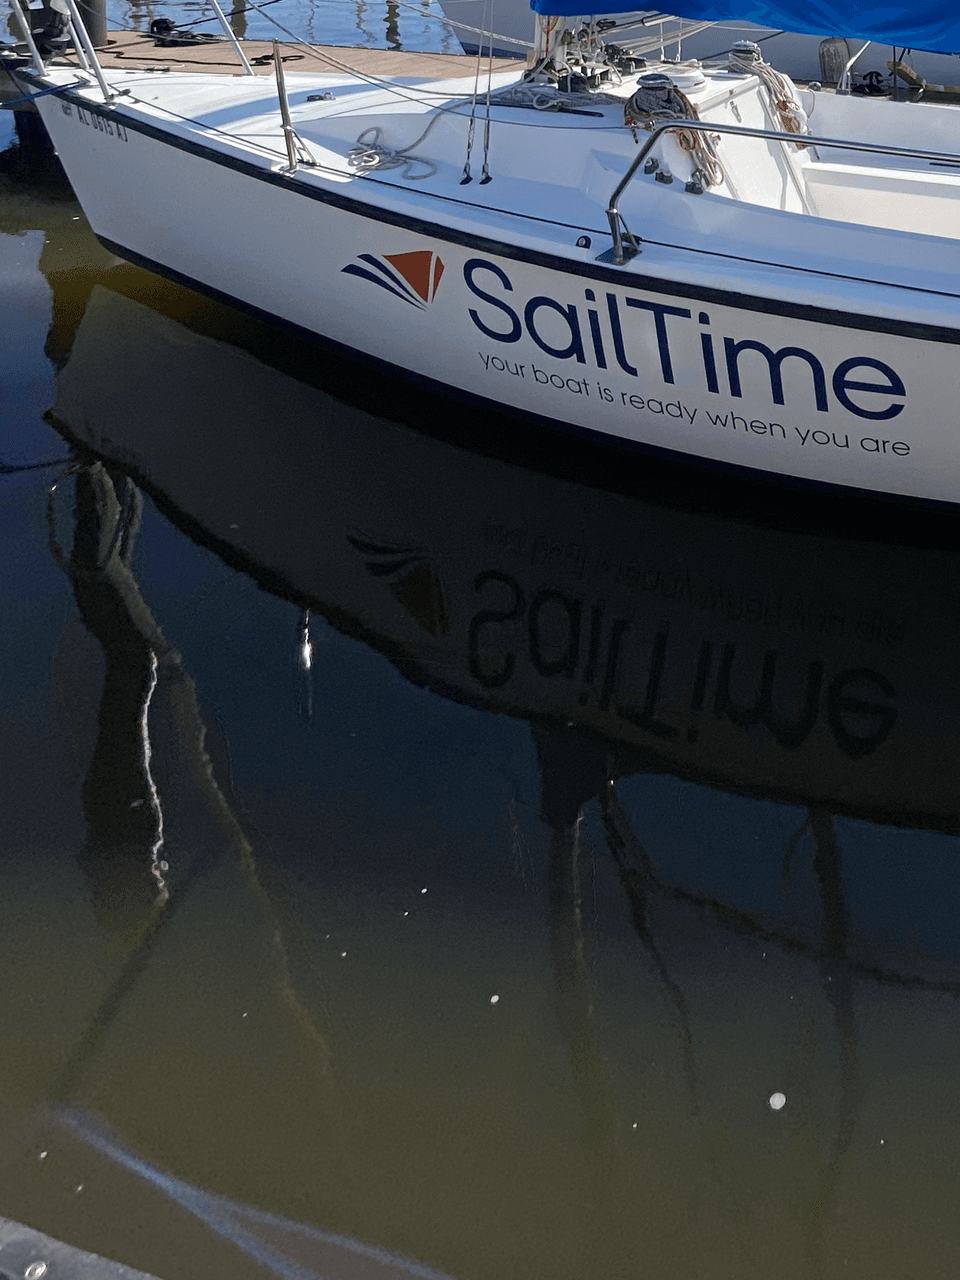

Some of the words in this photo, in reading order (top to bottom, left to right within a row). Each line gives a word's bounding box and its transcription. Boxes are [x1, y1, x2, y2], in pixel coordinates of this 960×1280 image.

[463, 258, 907, 421] SailTime
[479, 351, 525, 379] your
[532, 363, 590, 397] boat
[597, 382, 615, 404] is
[621, 389, 698, 424] ready
[706, 407, 786, 439] when
[795, 424, 850, 456] you
[860, 437, 911, 457] are
